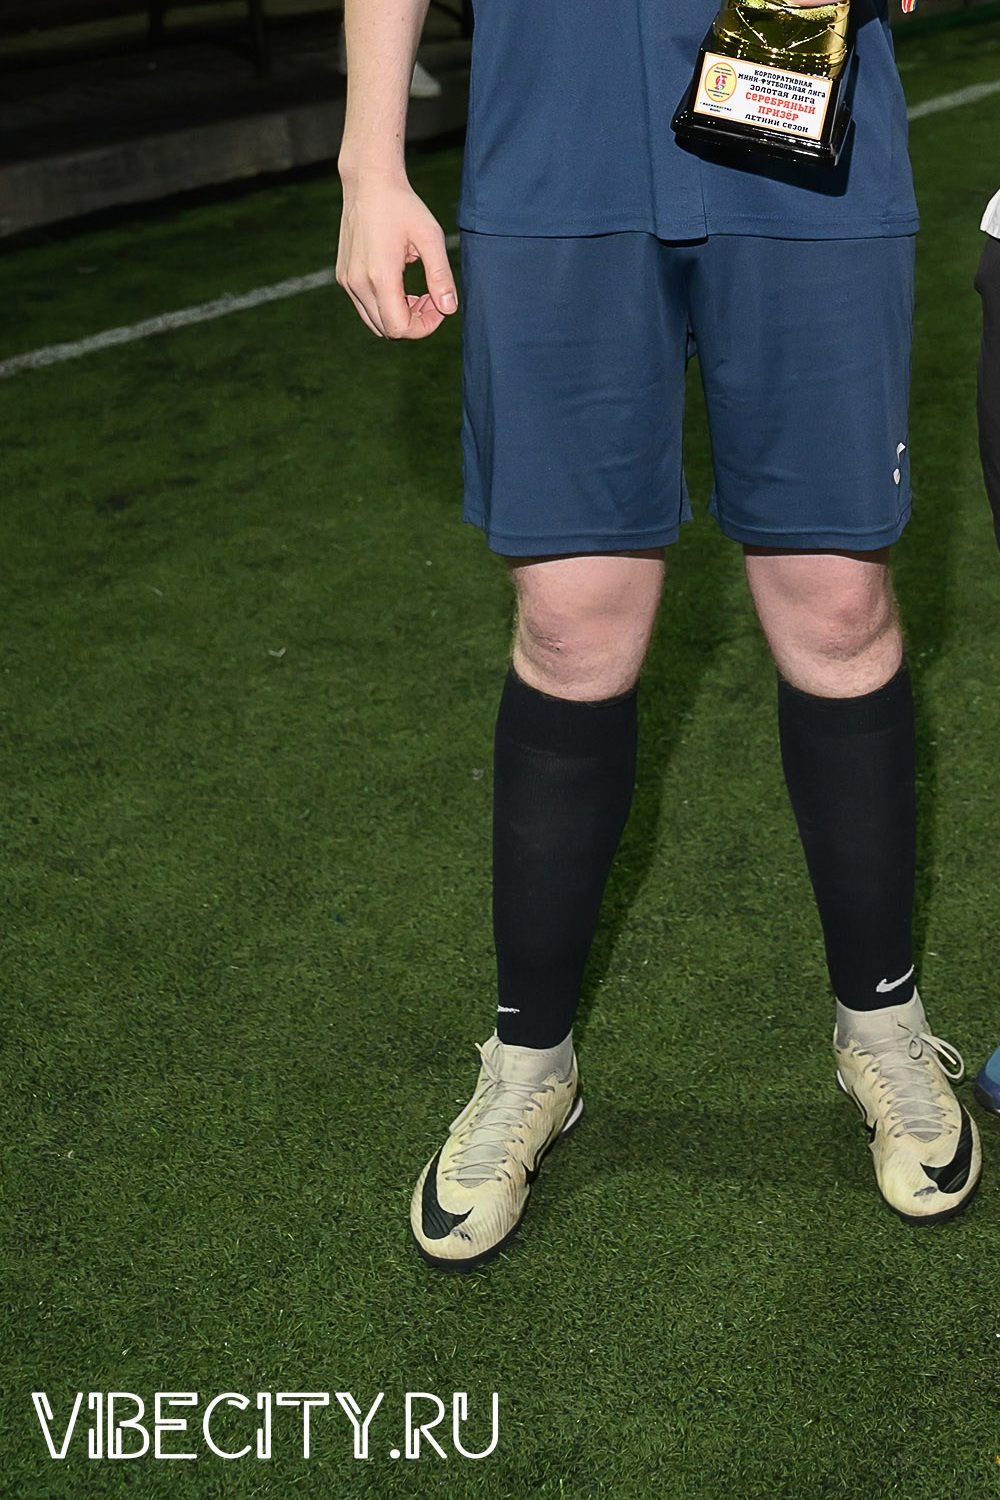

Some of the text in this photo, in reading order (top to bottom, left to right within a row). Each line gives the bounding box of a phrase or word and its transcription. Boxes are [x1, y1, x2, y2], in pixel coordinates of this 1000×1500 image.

[738, 73, 807, 94] МИНИ-ФУТБОЛЬНАЯ
[754, 69, 813, 88] КОРПОРАТИВНАЯ
[749, 84, 789, 99] ЗОЛОТАЯ
[745, 91, 817, 115] СЕРЕБРЯНЫЙ
[757, 105, 800, 121] ПРИЗЁР
